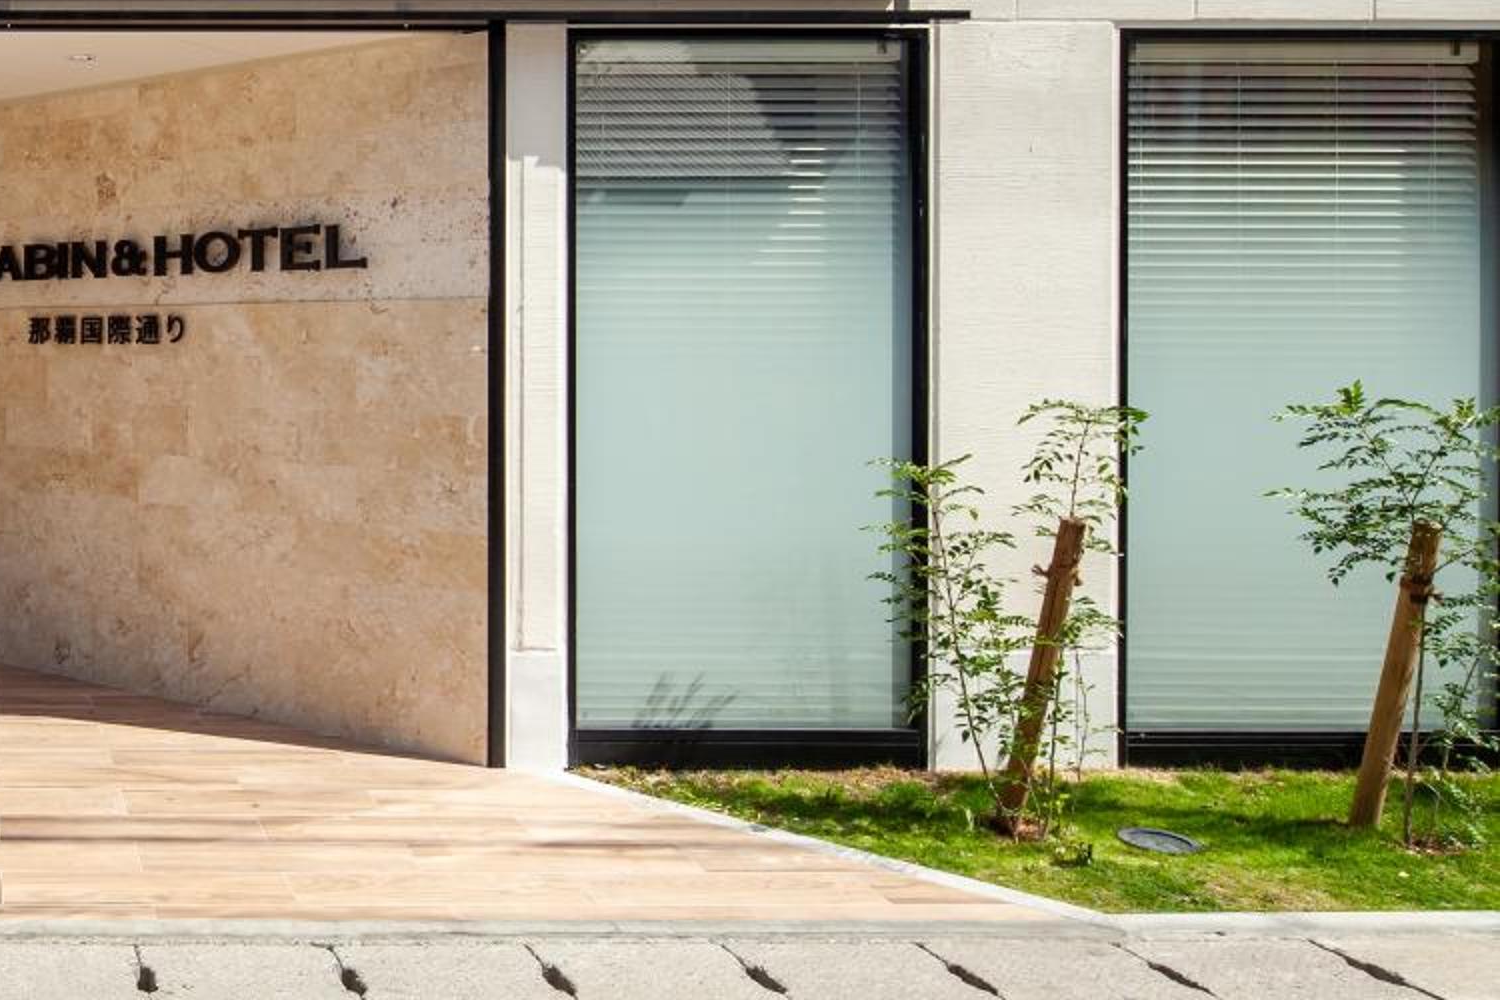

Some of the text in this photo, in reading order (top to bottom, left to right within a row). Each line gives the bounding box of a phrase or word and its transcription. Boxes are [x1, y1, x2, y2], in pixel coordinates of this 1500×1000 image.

[28, 314, 185, 345] 那覇国際通り
